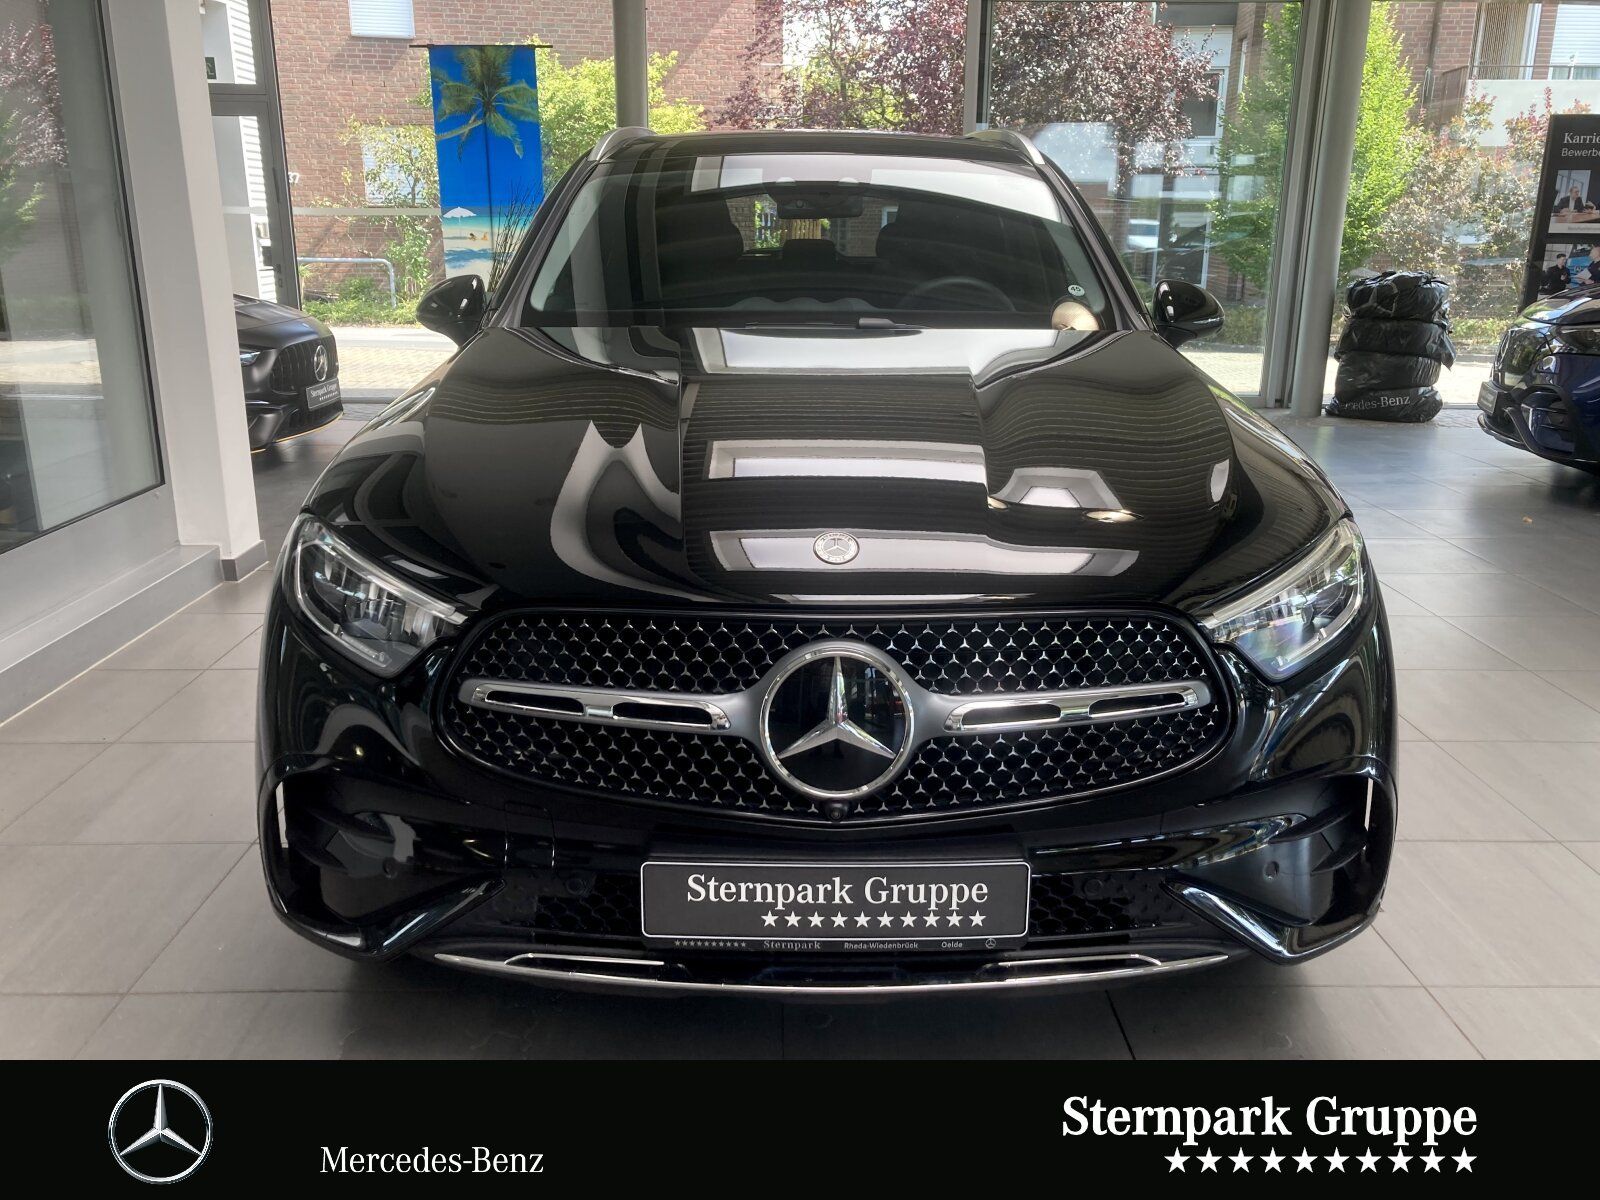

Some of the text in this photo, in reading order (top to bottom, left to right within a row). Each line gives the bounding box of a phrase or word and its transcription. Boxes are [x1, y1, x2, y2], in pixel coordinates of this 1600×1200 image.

[687, 873, 989, 910] Sternpark Gruppe
[763, 940, 821, 950] Sternpark
[844, 941, 919, 950] Rheda-Wiedenbrück
[941, 941, 963, 949] Oelde
